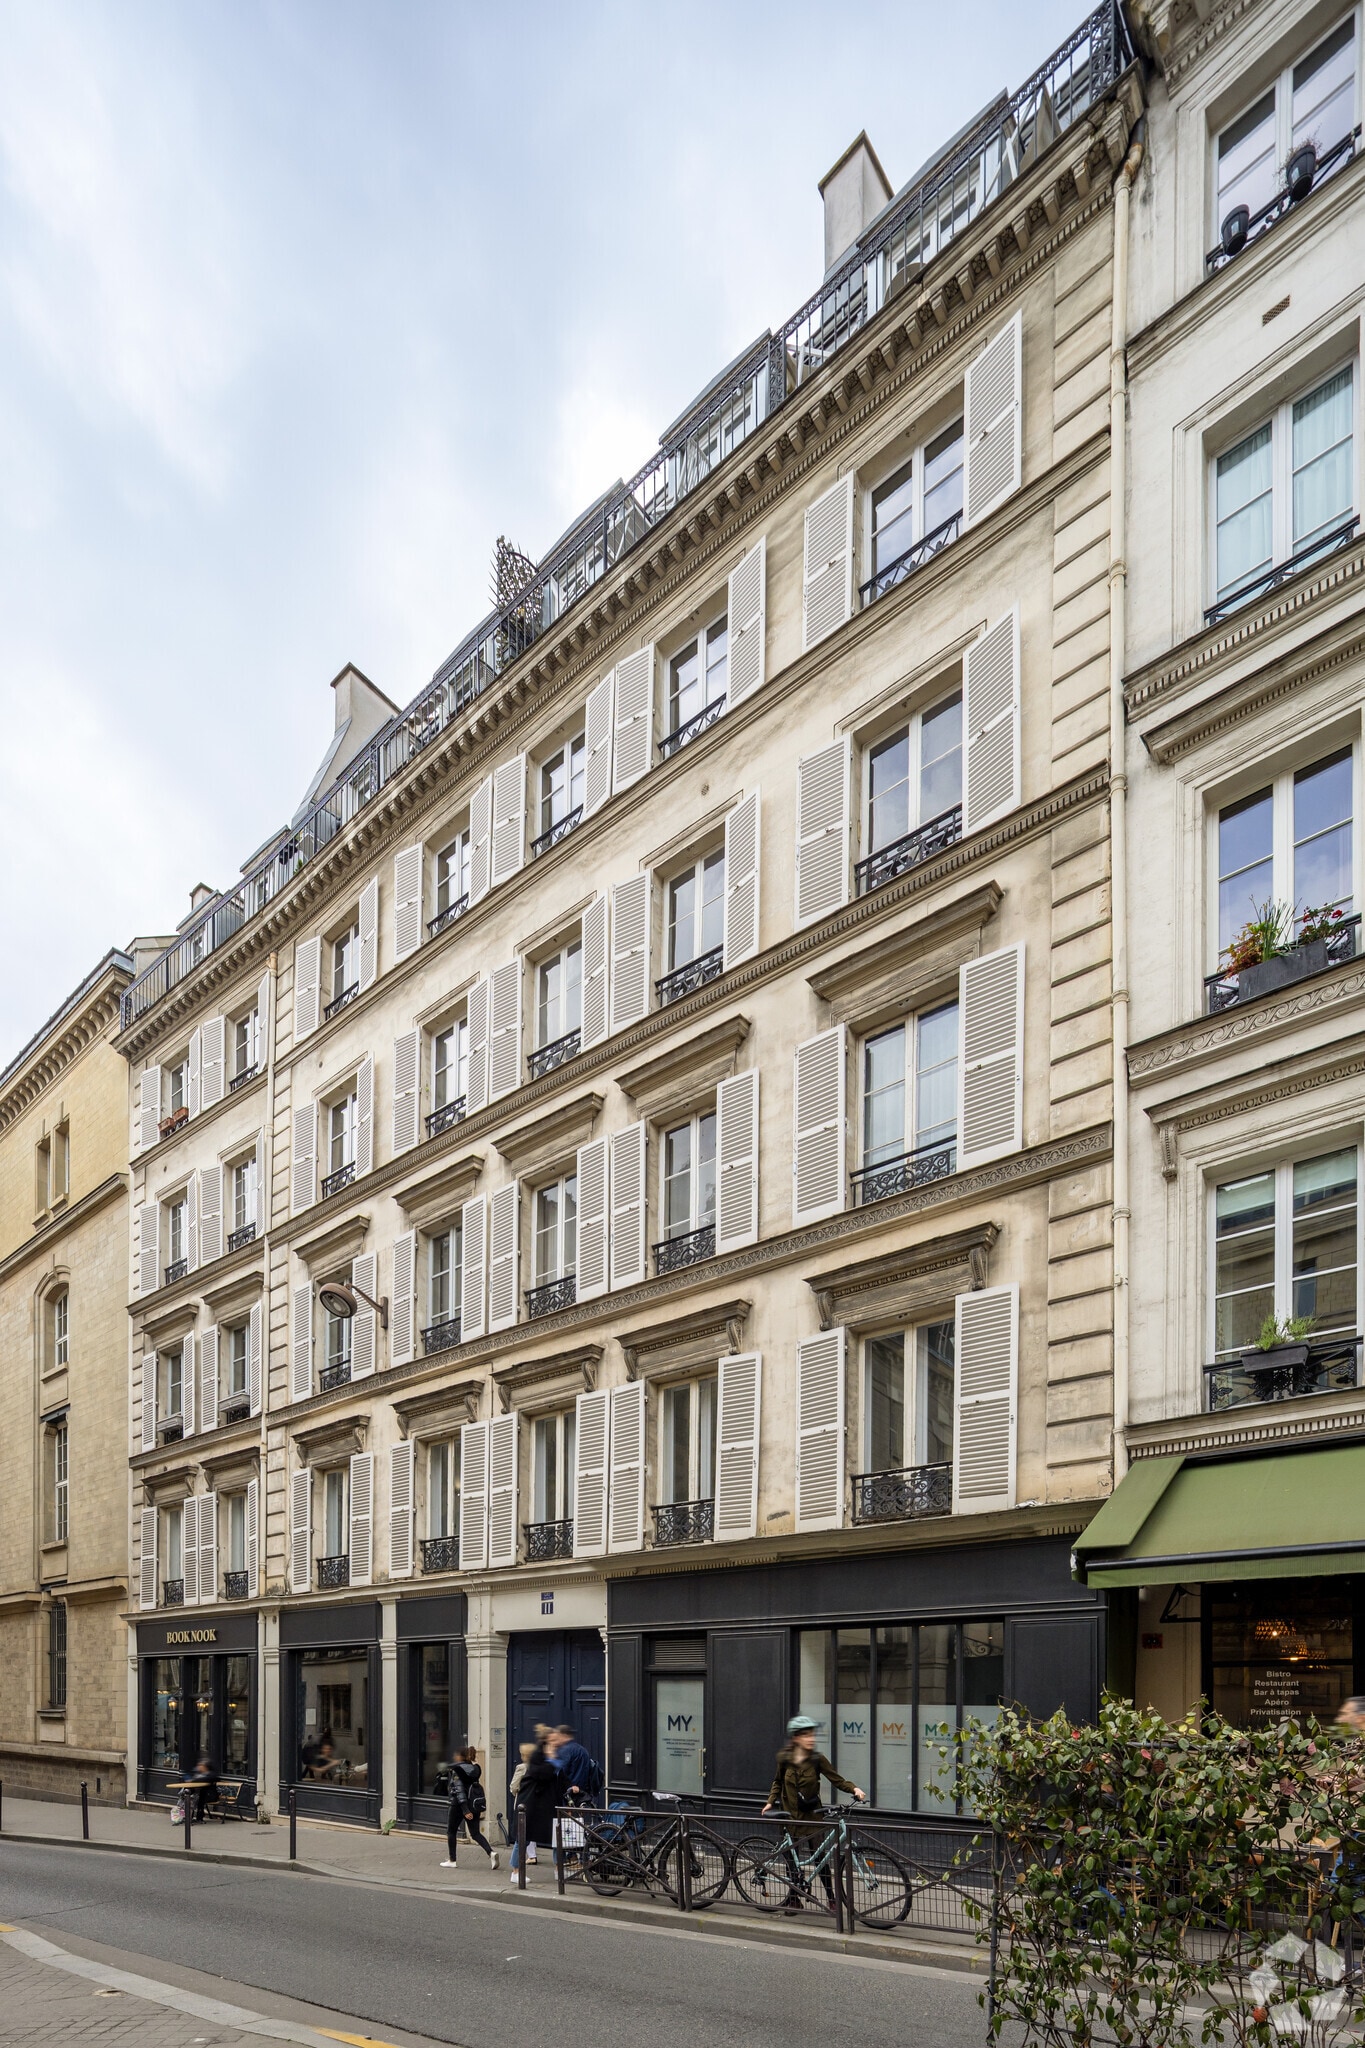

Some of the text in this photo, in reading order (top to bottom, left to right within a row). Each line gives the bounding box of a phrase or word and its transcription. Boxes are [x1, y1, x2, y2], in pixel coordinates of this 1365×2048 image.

[166, 1629, 217, 1644] BOOK NOOK
[1276, 1689, 1300, 1697] tapas
[1264, 1698, 1290, 1706] Apéro
[667, 1714, 696, 1732] MY.
[843, 1721, 867, 1734] MY.
[882, 1722, 907, 1736] MY.
